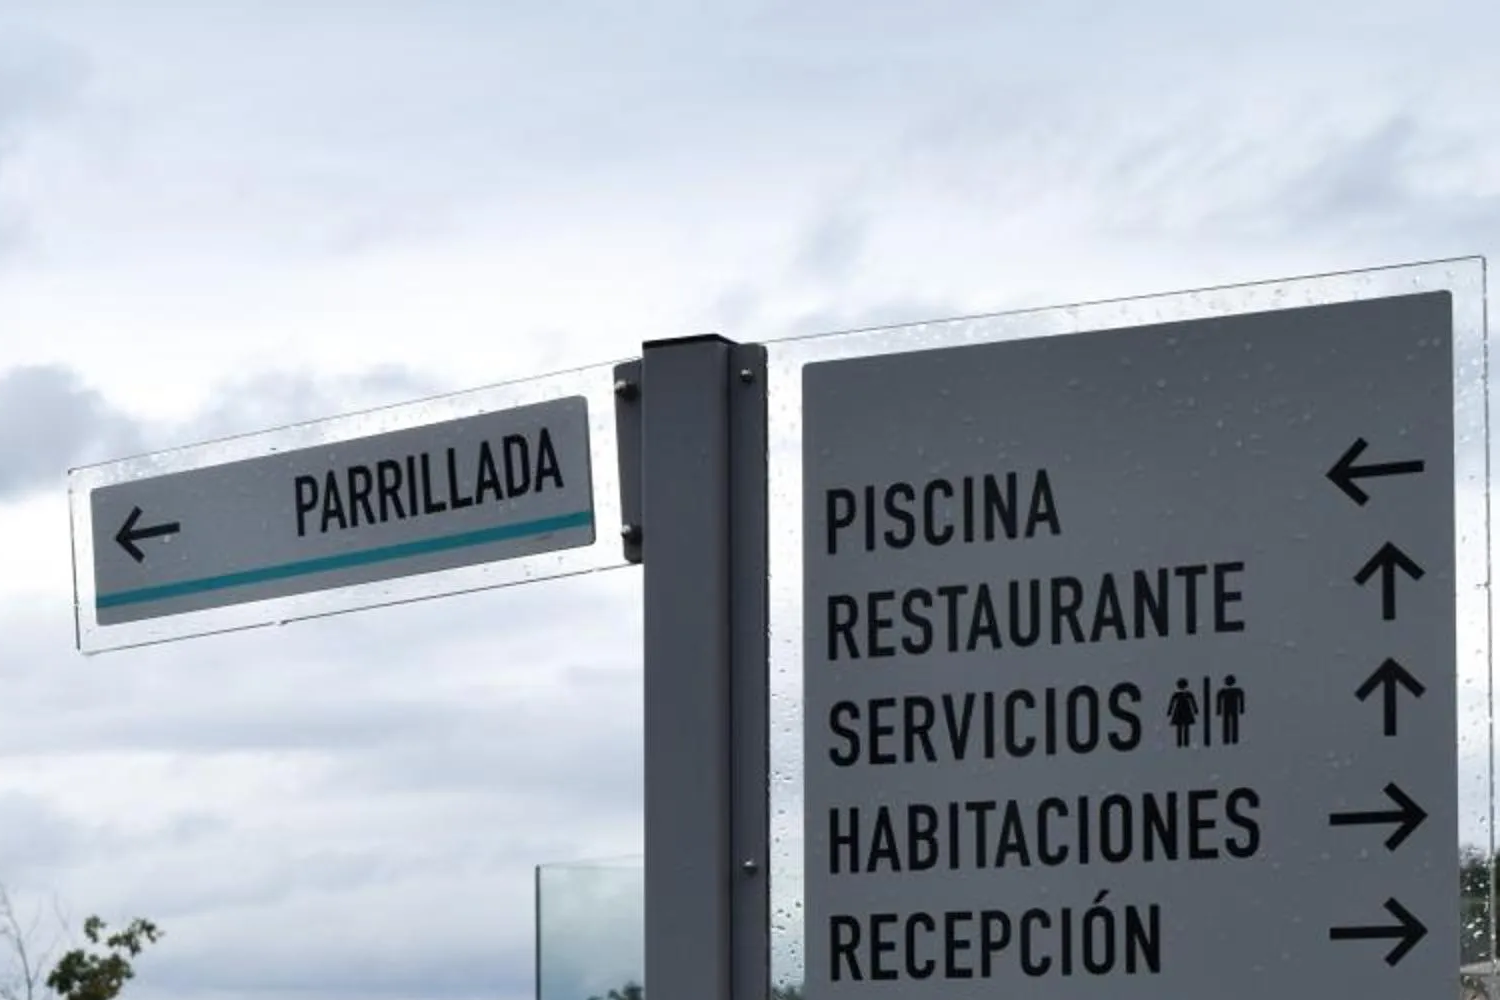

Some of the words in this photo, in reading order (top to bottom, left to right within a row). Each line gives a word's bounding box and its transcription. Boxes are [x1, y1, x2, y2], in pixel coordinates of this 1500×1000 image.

[294, 426, 565, 537] PARRILLADA
[826, 468, 1061, 556] PISCINA
[827, 561, 1245, 662] RESTAURANTE
[828, 681, 1142, 768] SERVICIOS
[829, 786, 1261, 875] HABITACIONES
[829, 889, 1161, 982] RECEPCIÓN
